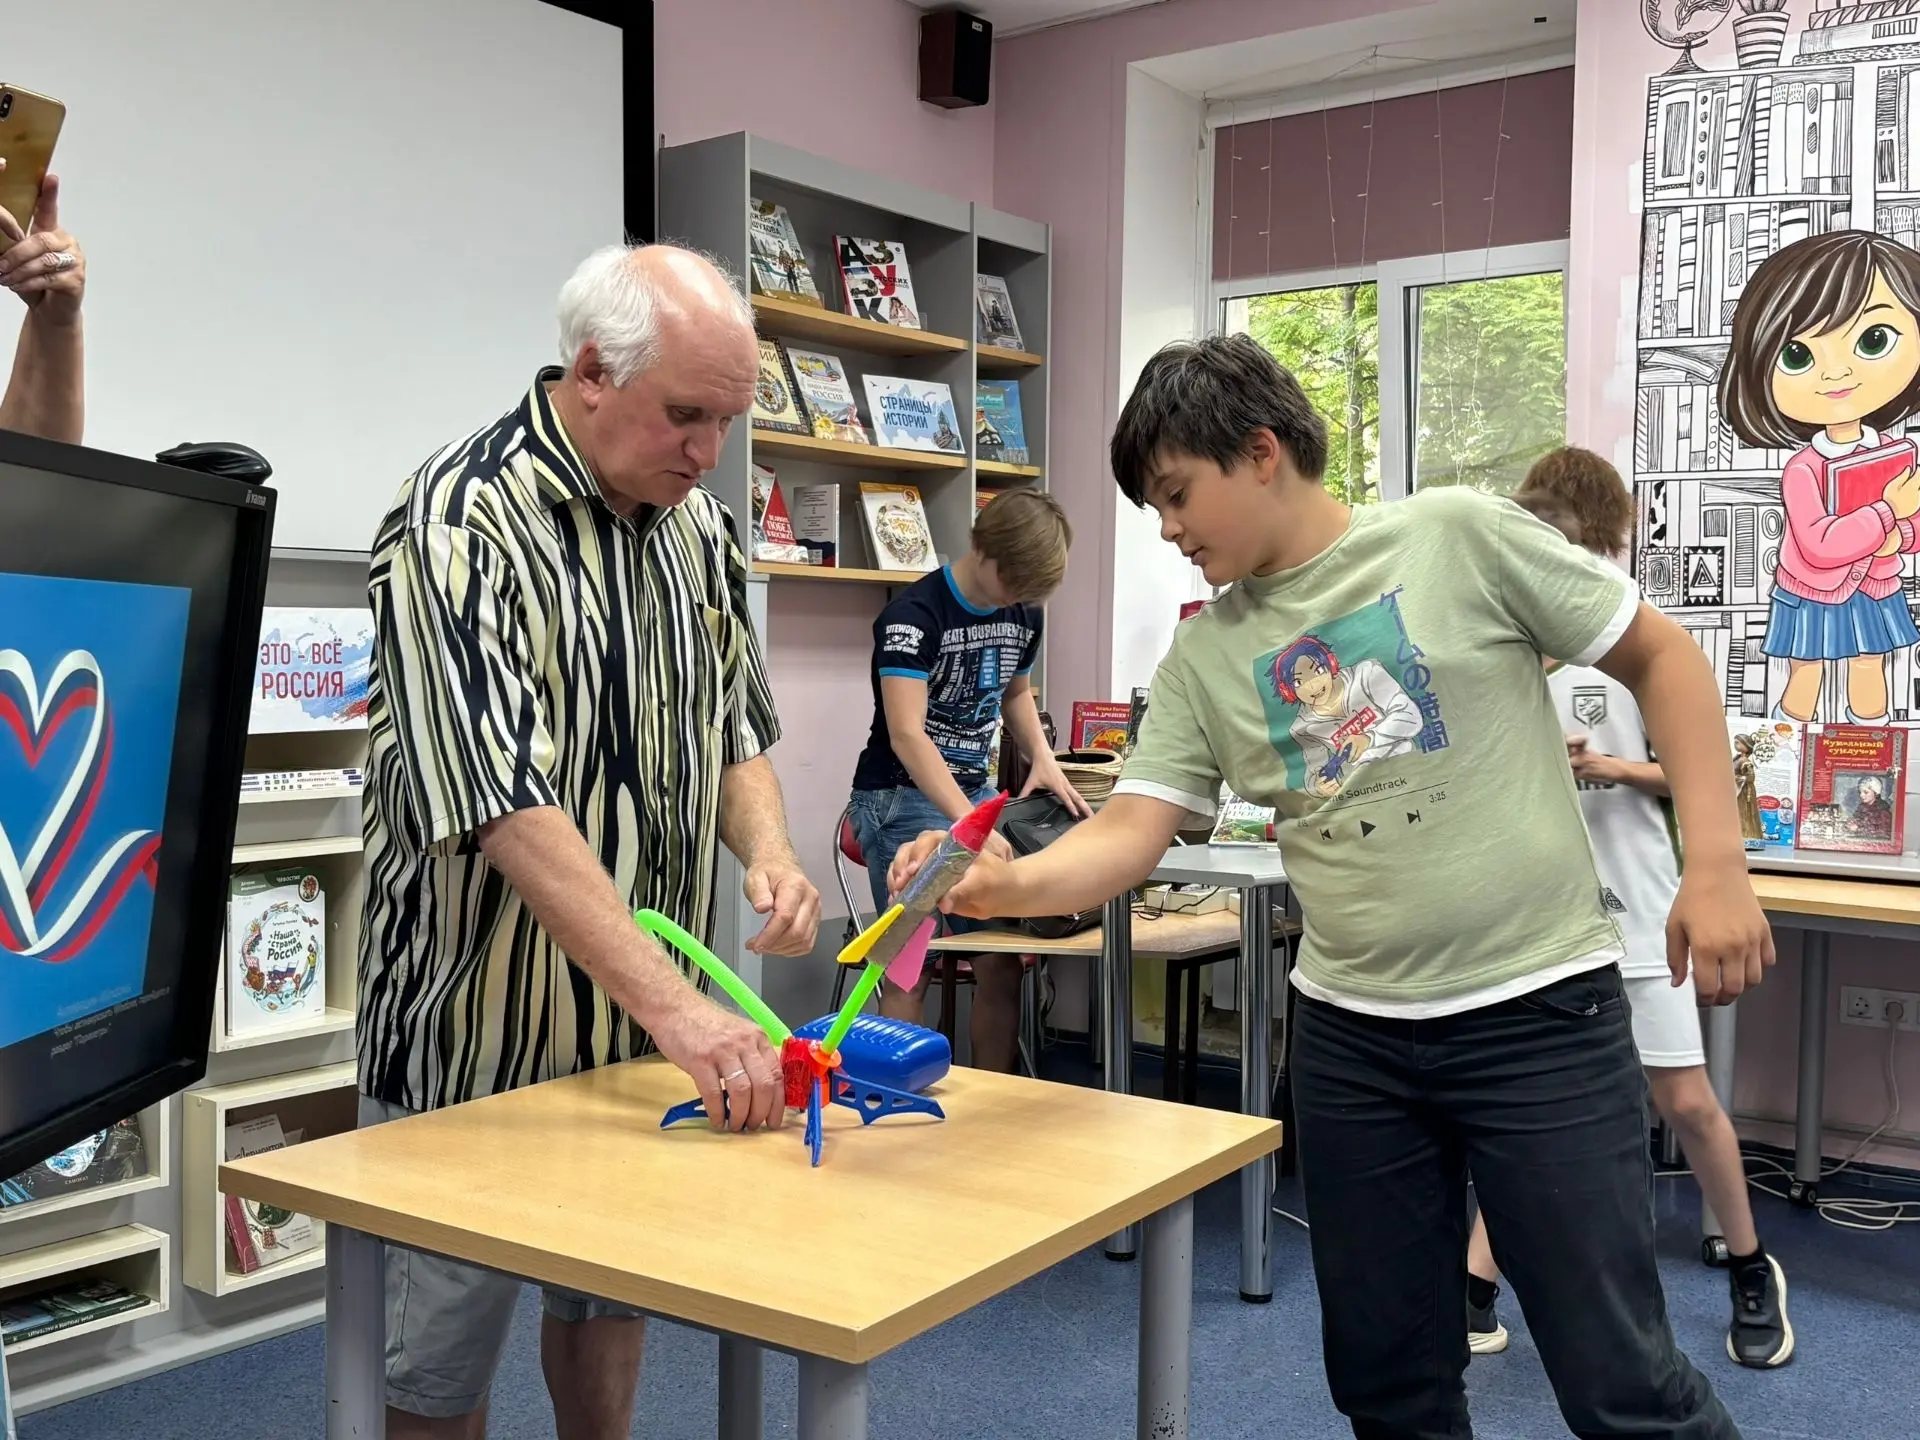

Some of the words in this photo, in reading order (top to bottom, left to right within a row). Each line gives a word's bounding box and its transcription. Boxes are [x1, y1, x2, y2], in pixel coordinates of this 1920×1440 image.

[812, 390, 845, 402] РОССИЯ
[880, 396, 932, 415] СТРАНИЦЫ
[883, 412, 929, 429] ИСТОРИИ
[261, 643, 291, 665] ЭТО
[312, 638, 343, 665] ВСЁ
[261, 671, 345, 700] РОССИЯ
[1345, 777, 1408, 799] Soundtrack
[1429, 791, 1447, 804] 3:25
[271, 938, 297, 950] страна
[273, 930, 294, 940] Наша
[267, 942, 303, 961] Россия
